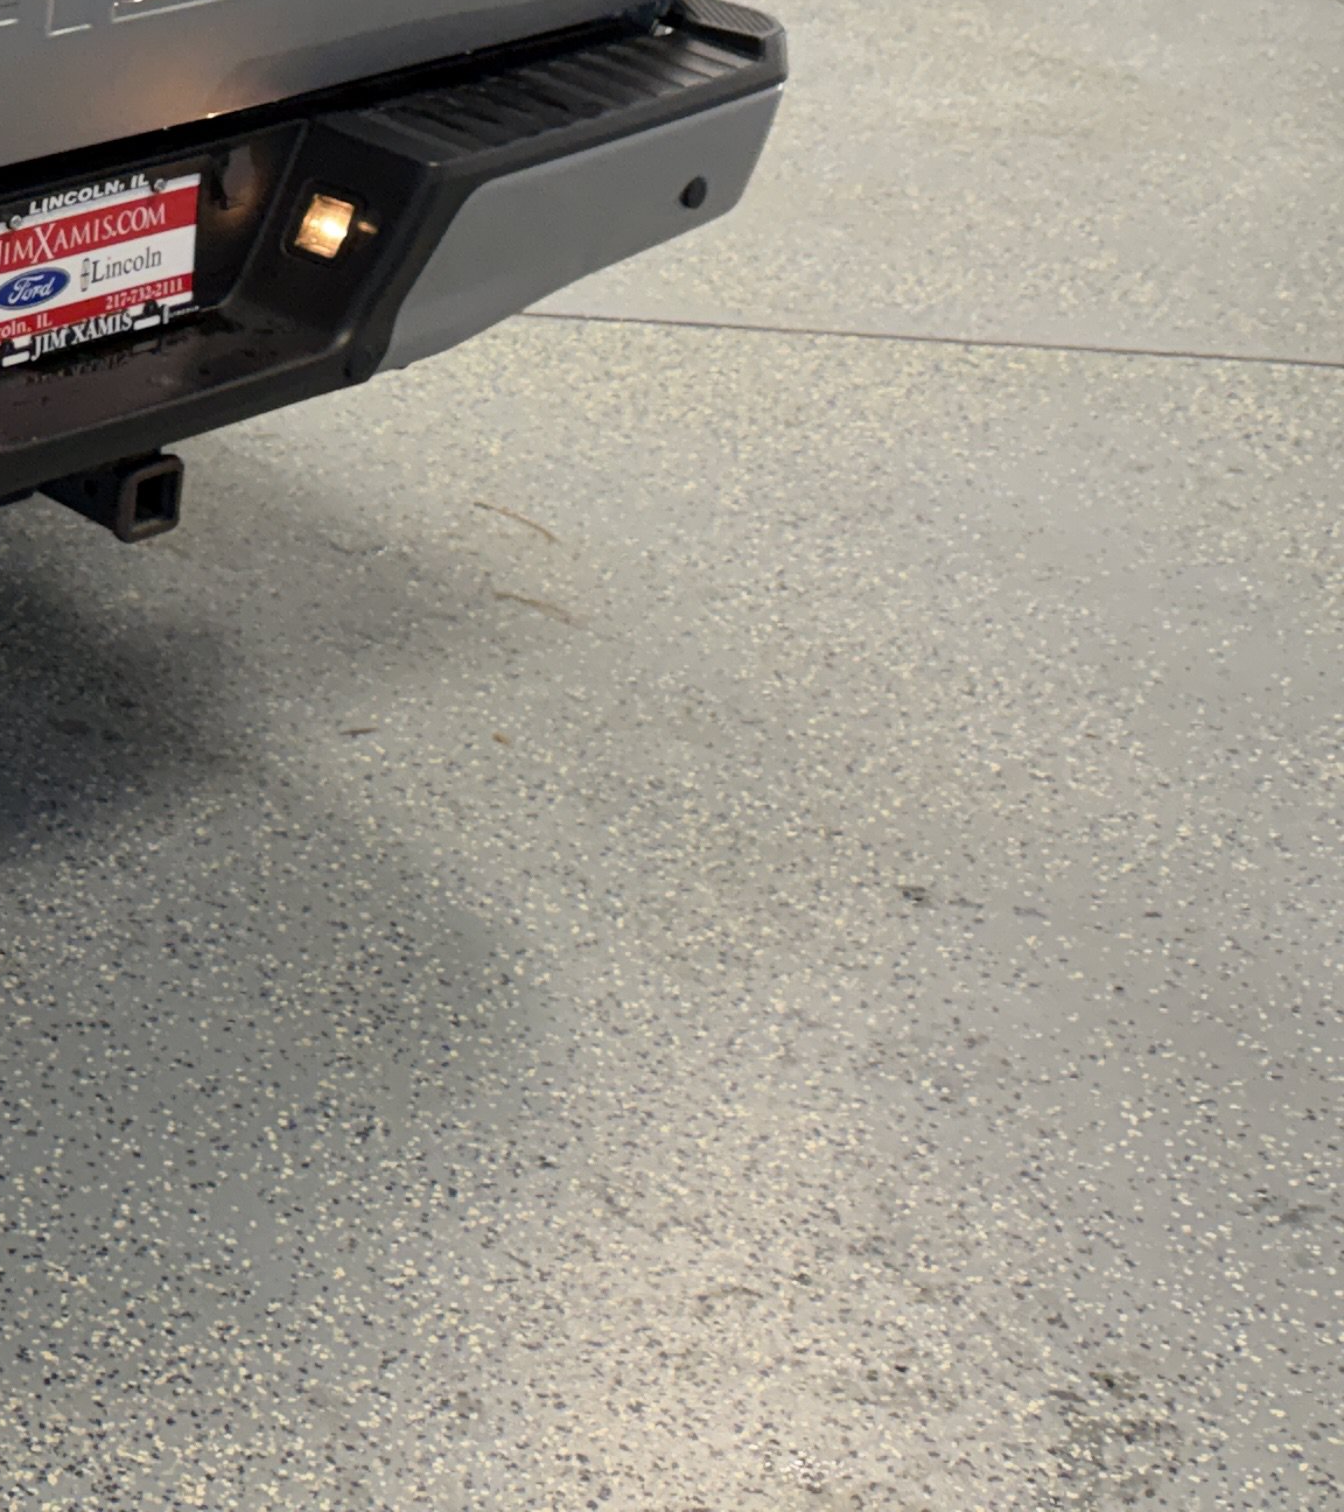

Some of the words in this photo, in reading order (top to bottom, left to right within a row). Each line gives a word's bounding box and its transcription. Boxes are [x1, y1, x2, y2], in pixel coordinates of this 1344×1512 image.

[130, 173, 149, 189] IL
[91, 246, 162, 284] Lincoln
[8, 274, 54, 305] Ford
[31, 328, 68, 361] JIM
[71, 311, 133, 345] XAMIS
[36, 313, 52, 329] IL
